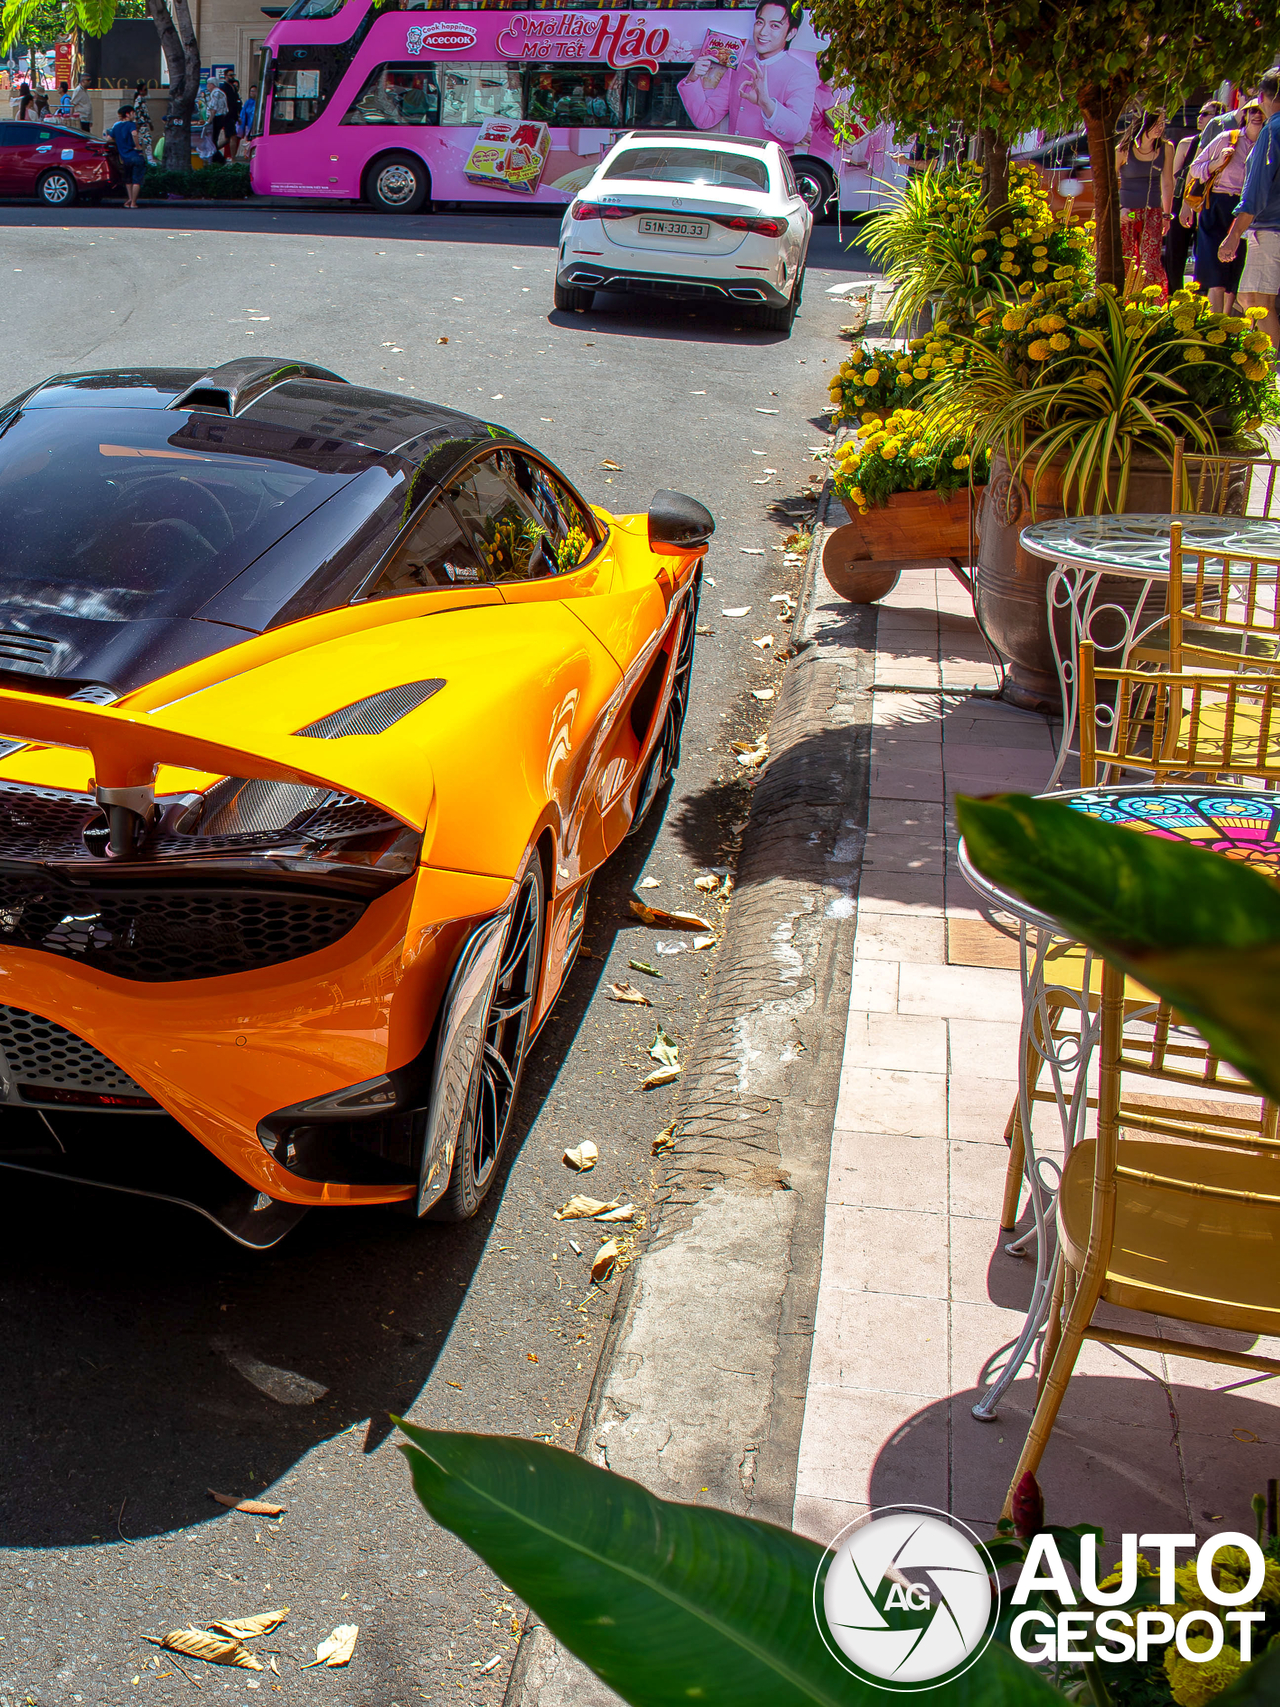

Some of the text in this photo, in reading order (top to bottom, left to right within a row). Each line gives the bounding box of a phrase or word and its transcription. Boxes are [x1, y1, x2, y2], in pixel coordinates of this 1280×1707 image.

[557, 13, 598, 36] Hảo
[555, 38, 586, 57] Tết
[588, 13, 670, 75] Hảo
